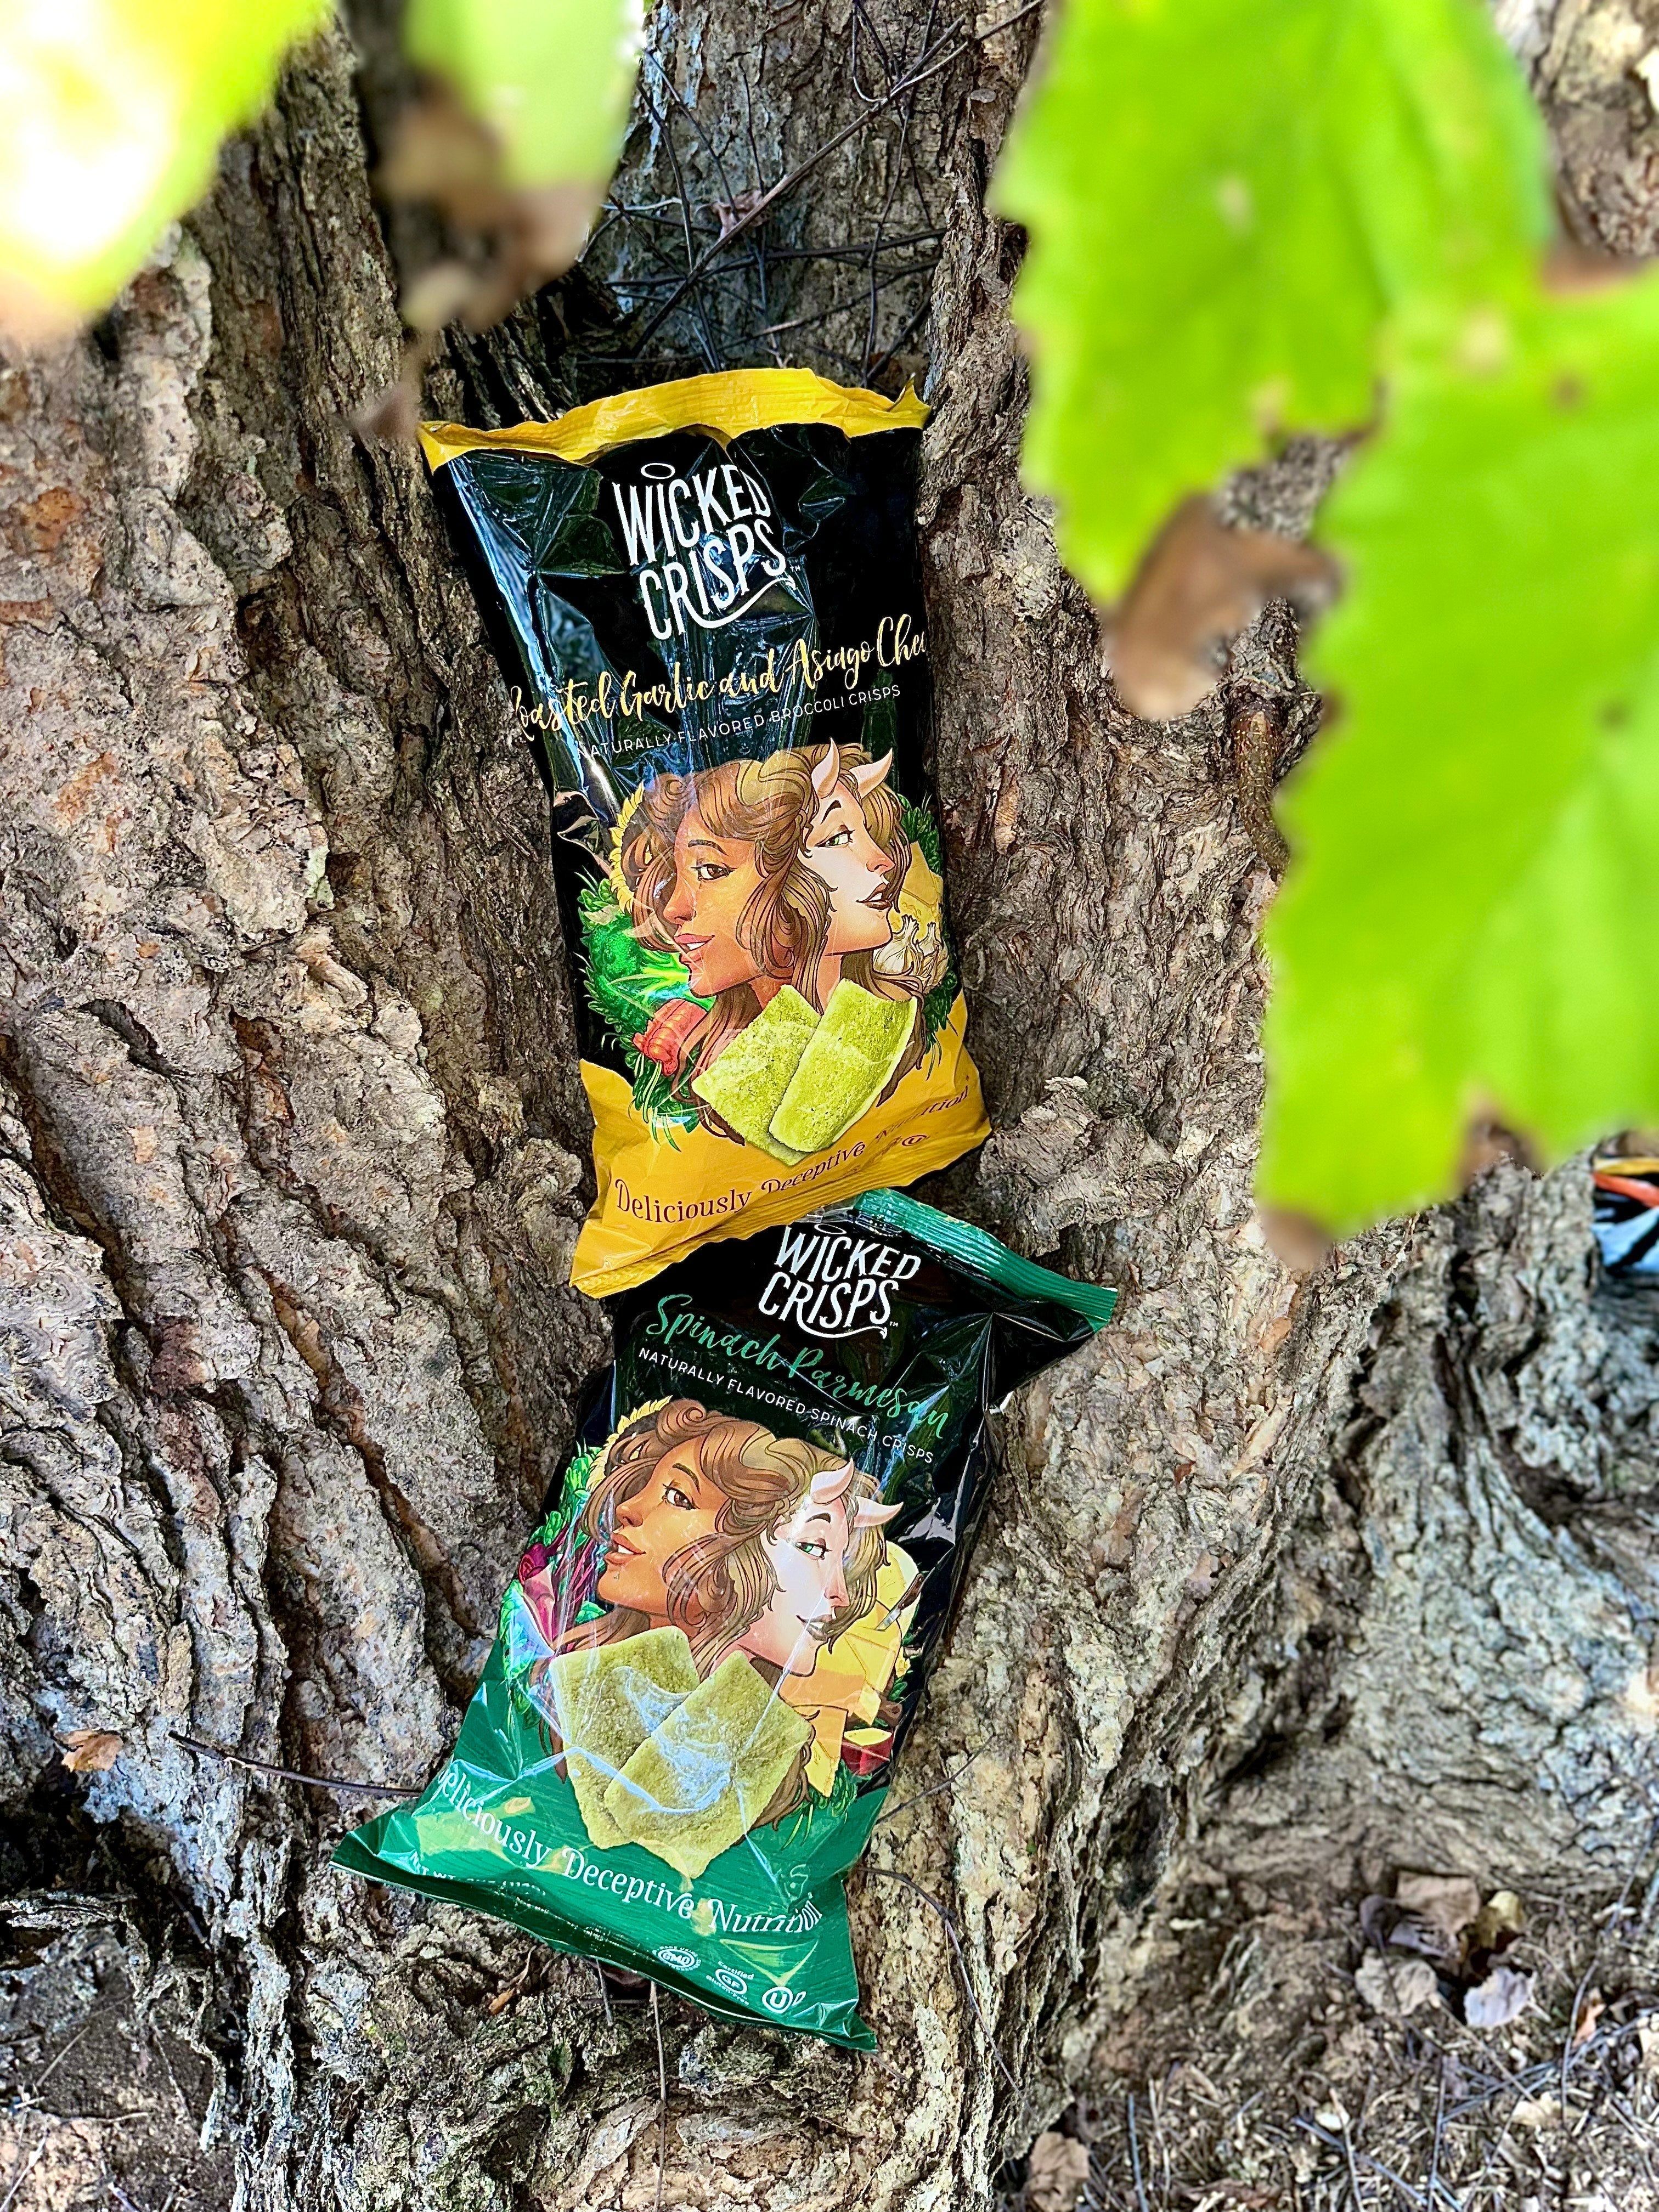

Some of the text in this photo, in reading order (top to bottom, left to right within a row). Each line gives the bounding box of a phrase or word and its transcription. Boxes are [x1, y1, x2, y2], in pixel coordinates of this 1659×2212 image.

[612, 465, 771, 566] WICKED
[640, 519, 796, 640] CRISPS
[619, 662, 714, 721] Garlic
[719, 648, 784, 698] and
[786, 639, 874, 690] Asiago
[577, 685, 901, 760] NATURALLY FLAVORED BROCCOLI CRISPS
[615, 1178, 753, 1223] Deliciously
[761, 1142, 866, 1193] Deceptive
[774, 1225, 921, 1283] WICKED
[758, 1272, 899, 1339] CRISPS
[639, 1347, 934, 1464] NATURALLY FLAVORED SPINACH CRISPS
[646, 1294, 949, 1439] Spinach Parmesan
[562, 1847, 695, 1920] Deceptive
[707, 1897, 822, 1933] Nutrition
